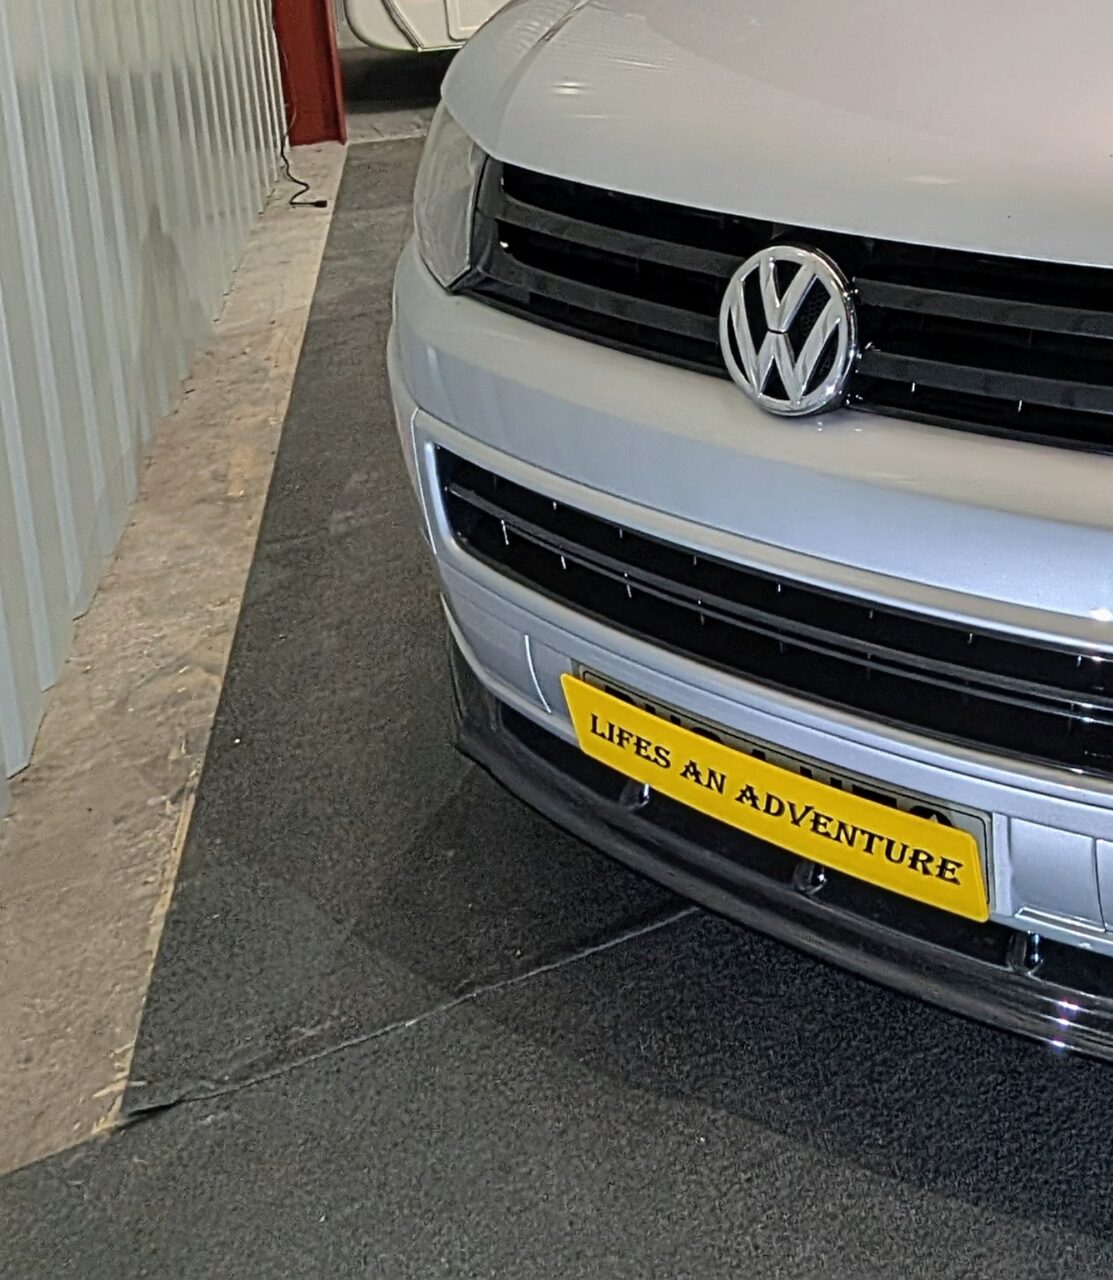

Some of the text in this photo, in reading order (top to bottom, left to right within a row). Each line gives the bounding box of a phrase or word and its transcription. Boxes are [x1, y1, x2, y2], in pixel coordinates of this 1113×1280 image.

[719, 245, 850, 417] VW
[590, 713, 671, 769] LIFES
[679, 759, 727, 795] AN
[734, 783, 964, 886] ADVENTURE
